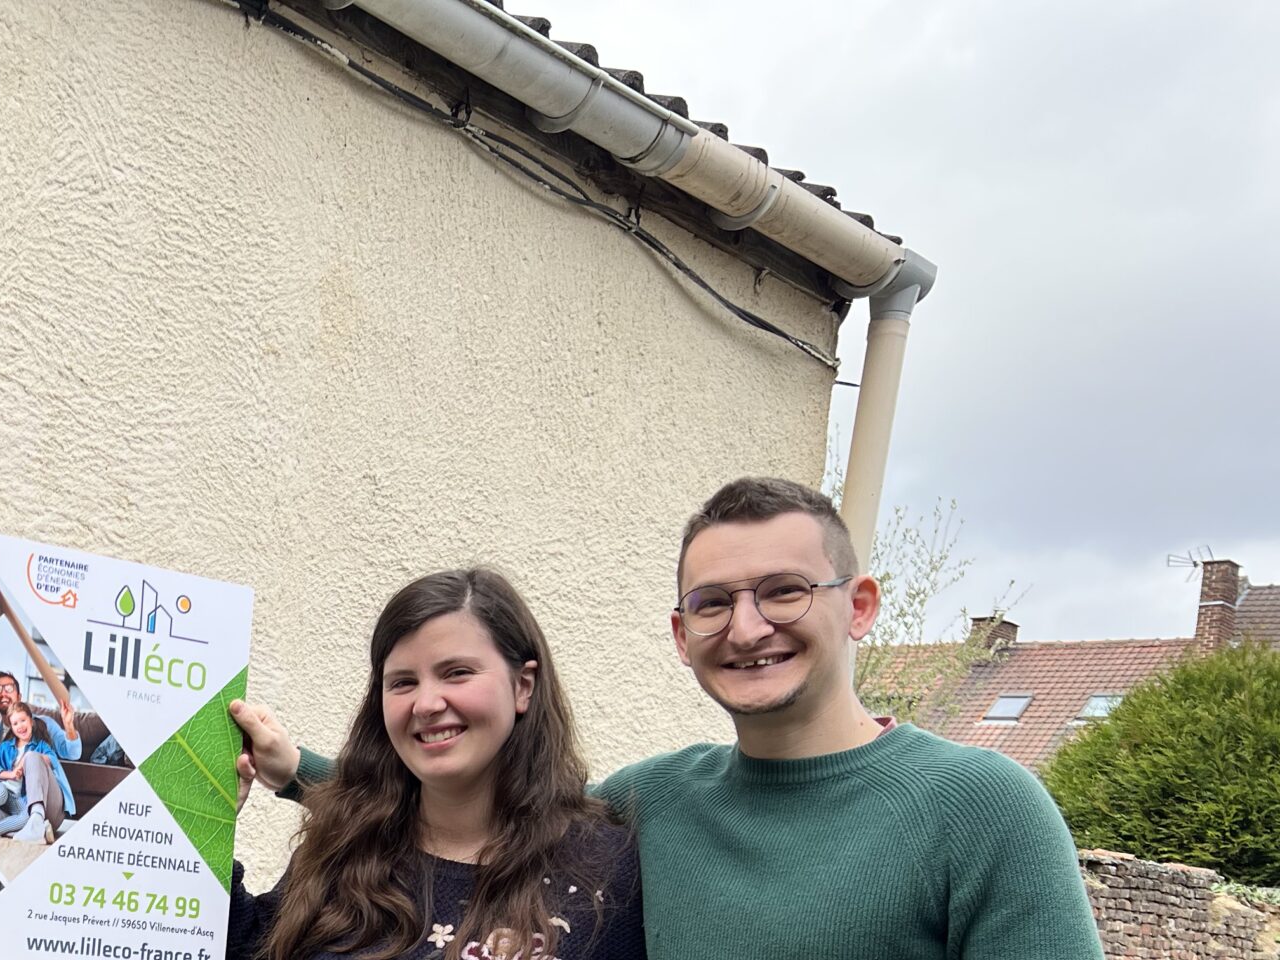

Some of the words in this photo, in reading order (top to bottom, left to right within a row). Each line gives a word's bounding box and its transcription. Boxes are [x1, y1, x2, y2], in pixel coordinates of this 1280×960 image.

[37, 563, 86, 581] ÉCONOMIES
[38, 555, 89, 573] PARTENAIRE
[36, 572, 80, 589] D'ÉNERGIE
[36, 582, 61, 594] D'EDF
[83, 630, 207, 692] Lilléco
[126, 690, 162, 705] FRANCE
[118, 801, 152, 818] NEUF
[92, 822, 173, 846] RÉNOVATION
[58, 844, 124, 865] GARANTIE
[127, 850, 200, 874] DÉCENNALE
[49, 882, 75, 906] 03
[82, 886, 106, 909] 74
[112, 890, 138, 912] 46
[145, 893, 169, 916] 74
[175, 896, 200, 919] 99
[27, 909, 33, 919] 2
[34, 913, 48, 921] rue
[49, 911, 80, 927] Jacques
[82, 914, 110, 927] Prévert
[120, 918, 147, 930] 59650
[149, 921, 214, 939] Villeneuve-d'Ascq
